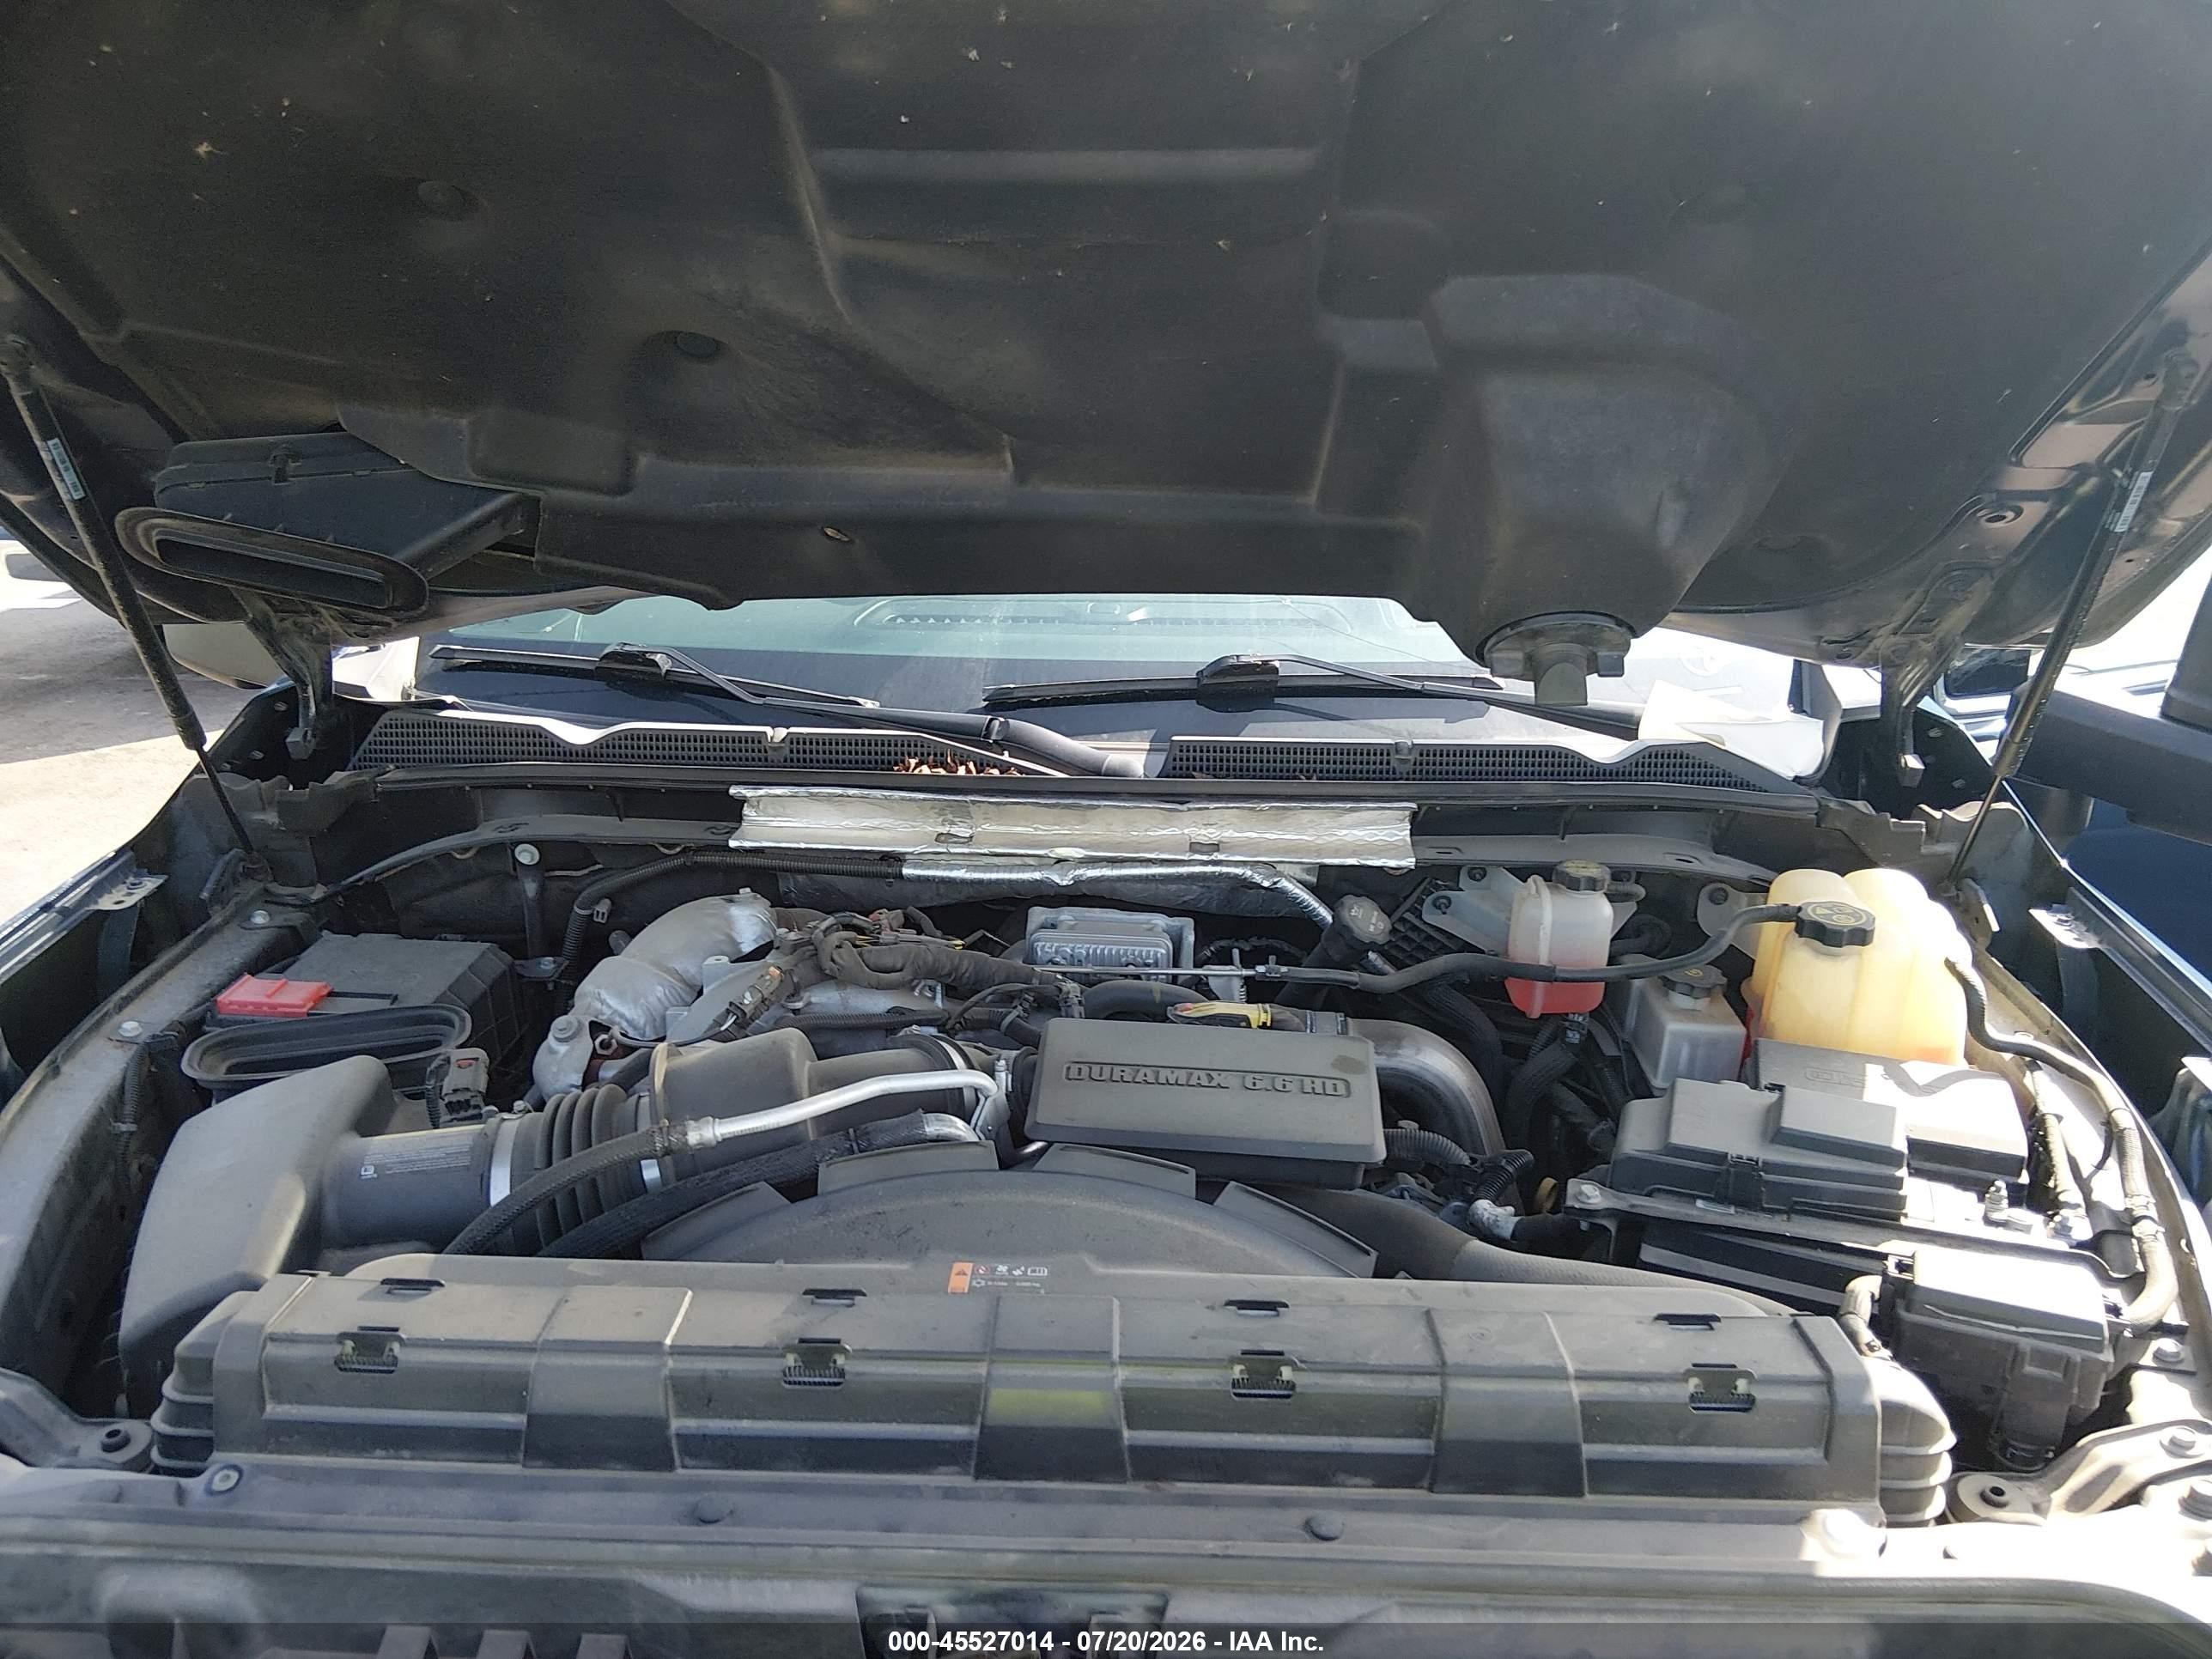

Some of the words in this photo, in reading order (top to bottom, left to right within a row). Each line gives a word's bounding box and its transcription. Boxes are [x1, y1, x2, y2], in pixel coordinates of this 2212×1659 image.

[1066, 1063, 1230, 1089] DURAMAX
[1243, 1073, 1294, 1093] 6.6
[1302, 1078, 1346, 1097] HD
